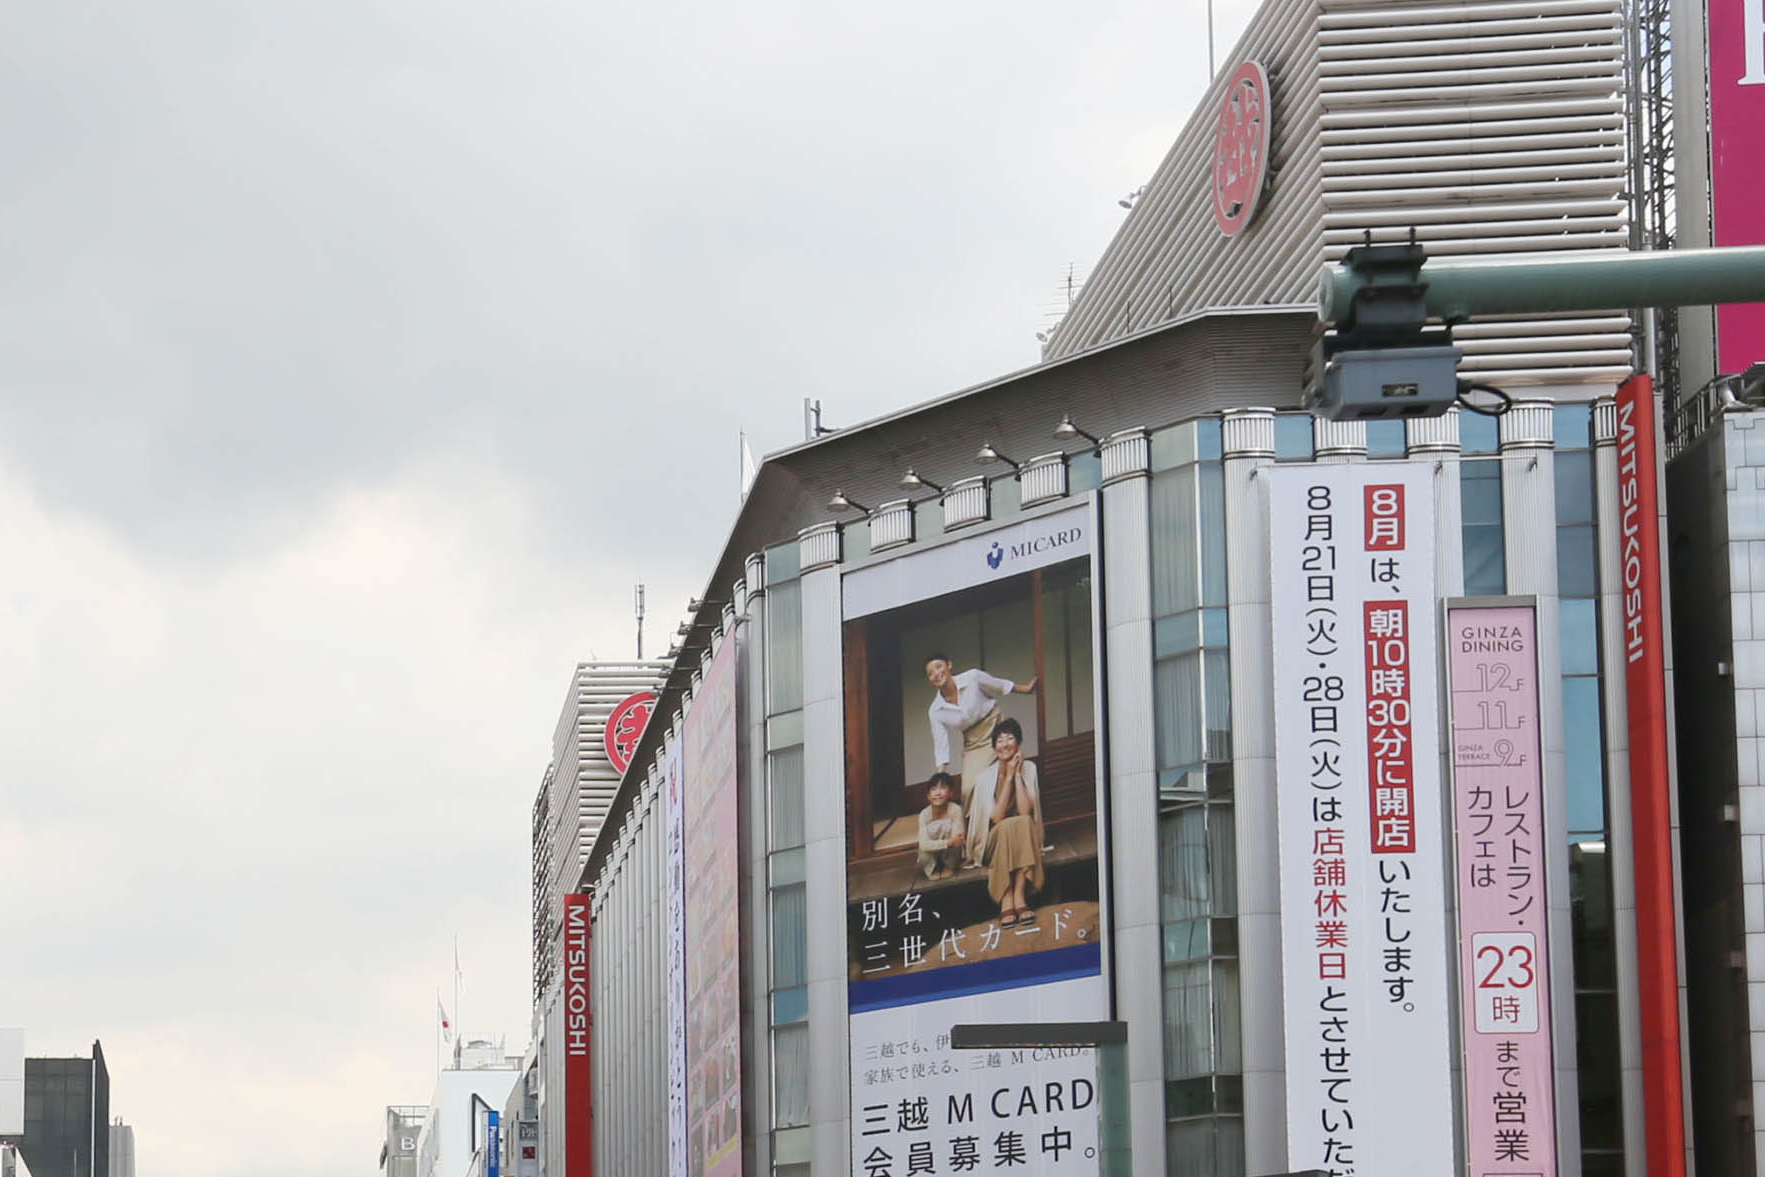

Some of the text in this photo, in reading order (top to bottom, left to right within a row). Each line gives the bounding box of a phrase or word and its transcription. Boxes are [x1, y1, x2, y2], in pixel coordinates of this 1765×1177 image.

[1010, 526, 1083, 560] MICARD
[1620, 400, 1644, 664] MITSUKOSHI
[1462, 627, 1522, 639] GINZA
[1462, 640, 1523, 653] DINING
[1476, 662, 1525, 692] 12F
[1477, 701, 1526, 730] 11F
[1467, 785, 1497, 888] カフェは
[861, 893, 942, 932] 別名、
[861, 908, 1091, 975] 三世代カード。
[569, 905, 587, 1057] MITSUKOSHI
[865, 1060, 959, 1086] 家族で使える、
[970, 1052, 1002, 1071] 三越
[1011, 1051, 1024, 1066] M
[861, 1079, 1095, 1137] 三越 M CARD
